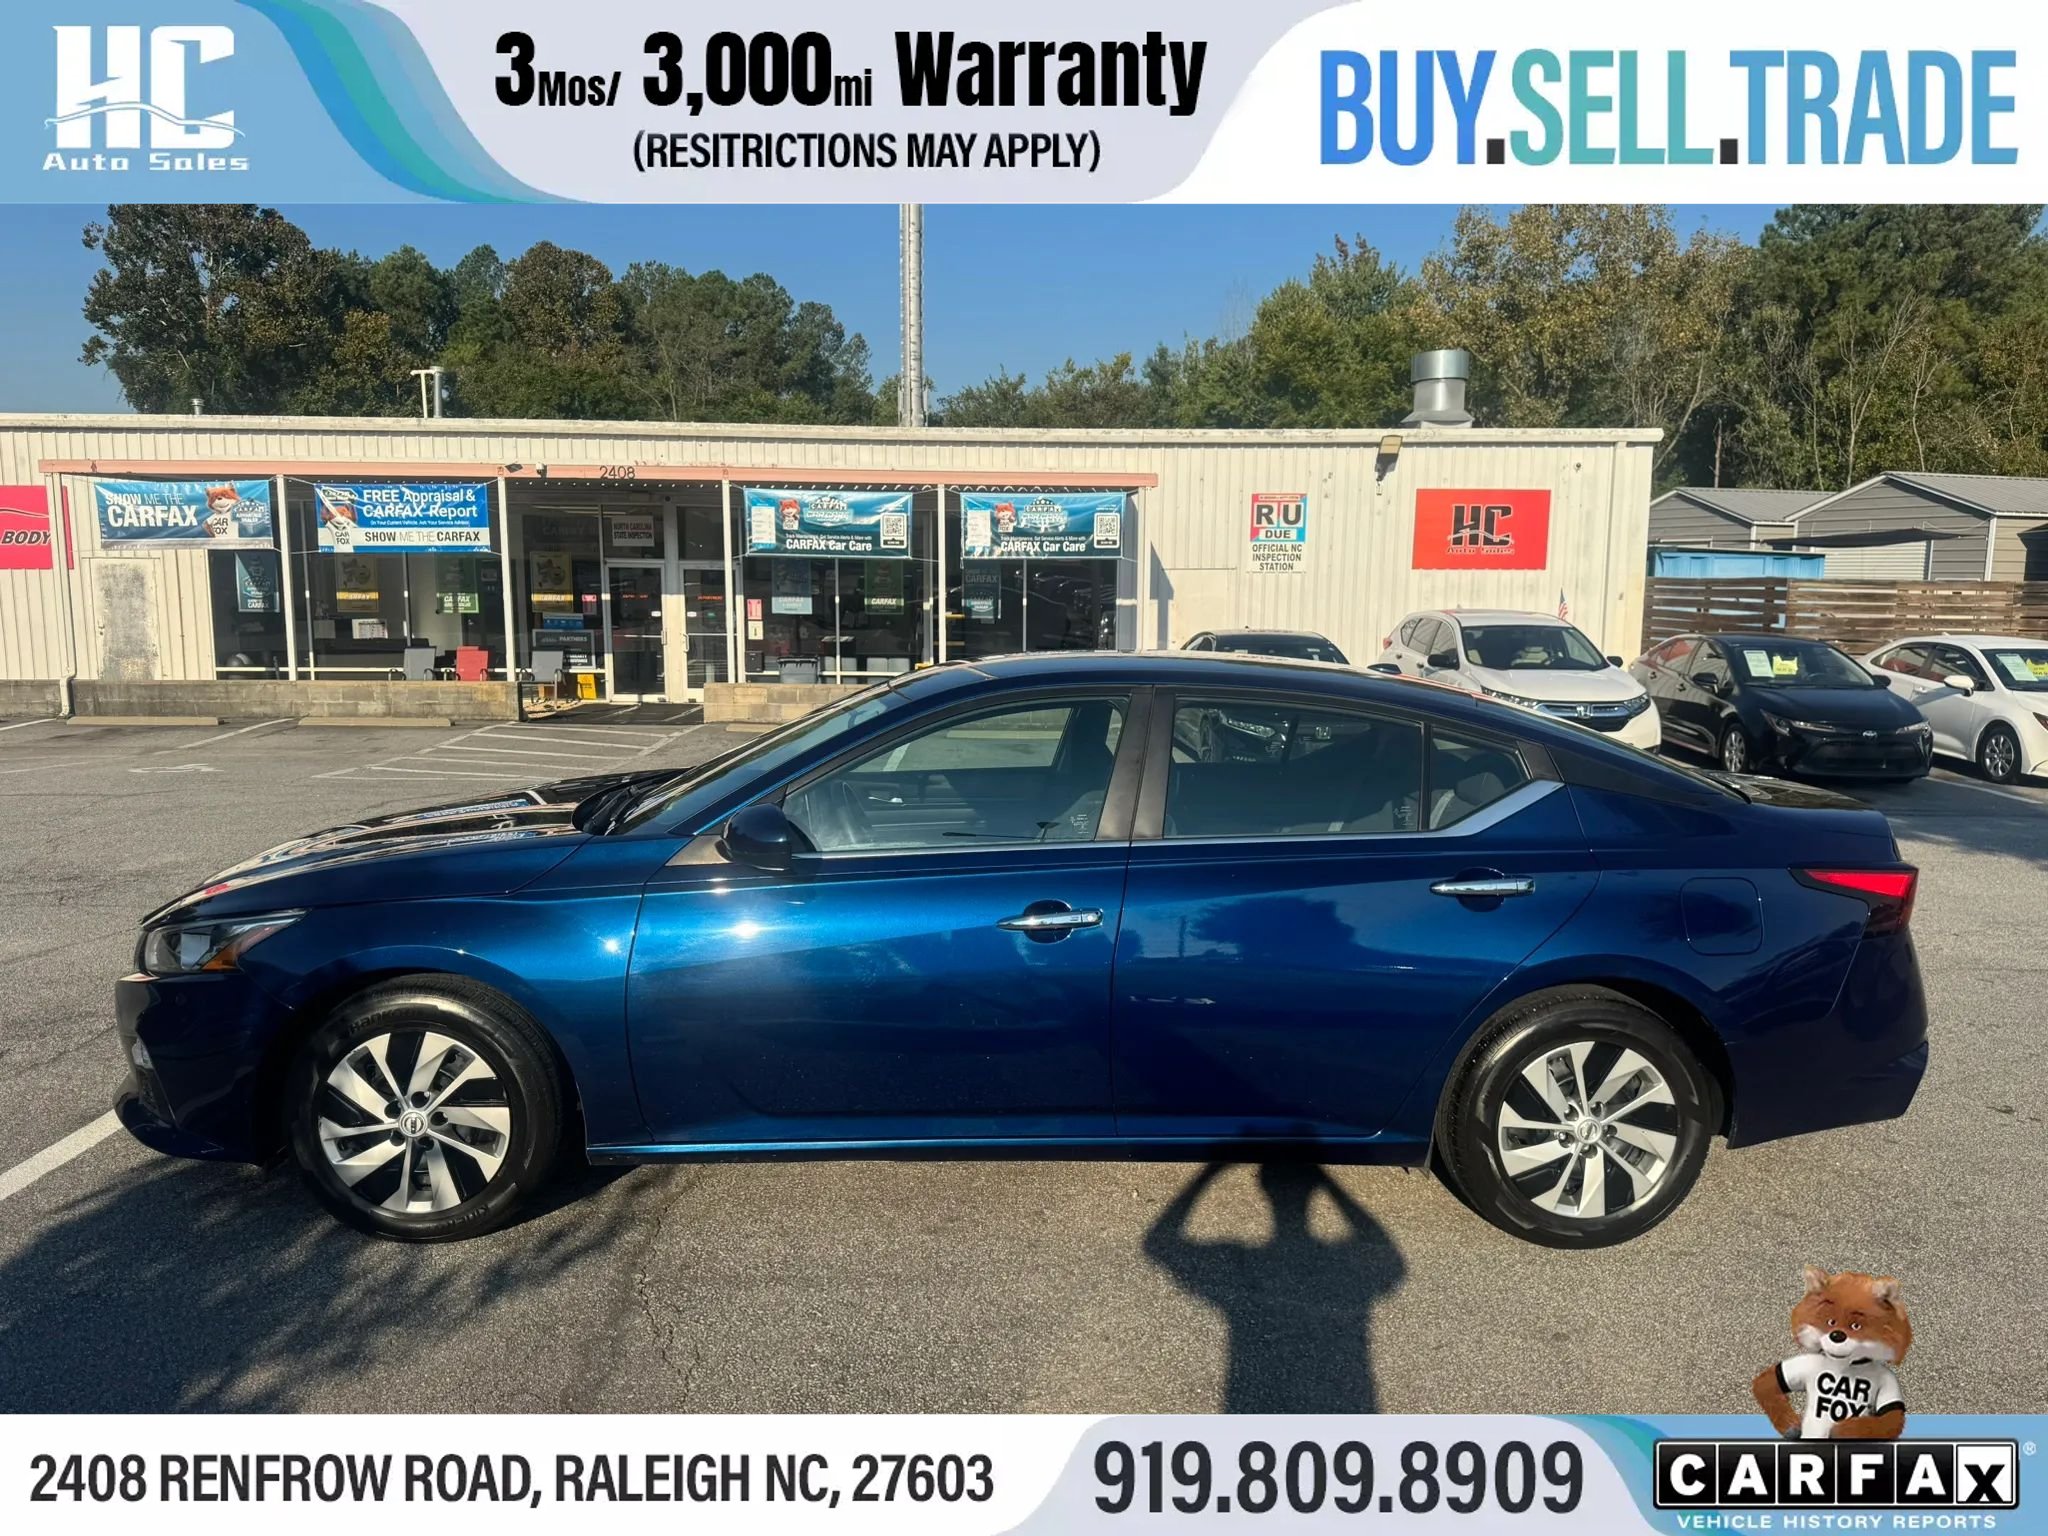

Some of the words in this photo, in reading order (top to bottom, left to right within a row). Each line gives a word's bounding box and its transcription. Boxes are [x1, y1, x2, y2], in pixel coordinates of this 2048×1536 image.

[600, 465, 636, 480] 2408
[105, 493, 142, 505] SHOW
[144, 493, 163, 504] ME
[163, 493, 184, 504] THE
[363, 489, 400, 502] FREE
[403, 489, 463, 506] Appraisal
[466, 490, 476, 502] &
[107, 505, 198, 527] CARFAX
[363, 504, 423, 518] CARFAX
[429, 504, 478, 520] Report
[1450, 504, 1513, 547] HC
[365, 531, 396, 543] SHOW
[399, 531, 414, 542] ME
[417, 531, 435, 542] THE
[436, 531, 480, 542] CARFAX
[1265, 529, 1291, 539] DUE
[786, 539, 827, 551] CARFAX
[828, 540, 845, 551] Car
[848, 541, 872, 551] Care
[1001, 541, 1040, 552] CARFAX
[1043, 541, 1060, 552] Car
[1062, 541, 1086, 552] Care
[1252, 543, 1289, 552] OFFICIAL
[1291, 543, 1303, 552] NC
[1252, 553, 1302, 562] INSPECTION
[1259, 562, 1294, 571] STATION
[443, 595, 471, 603] CAFAX
